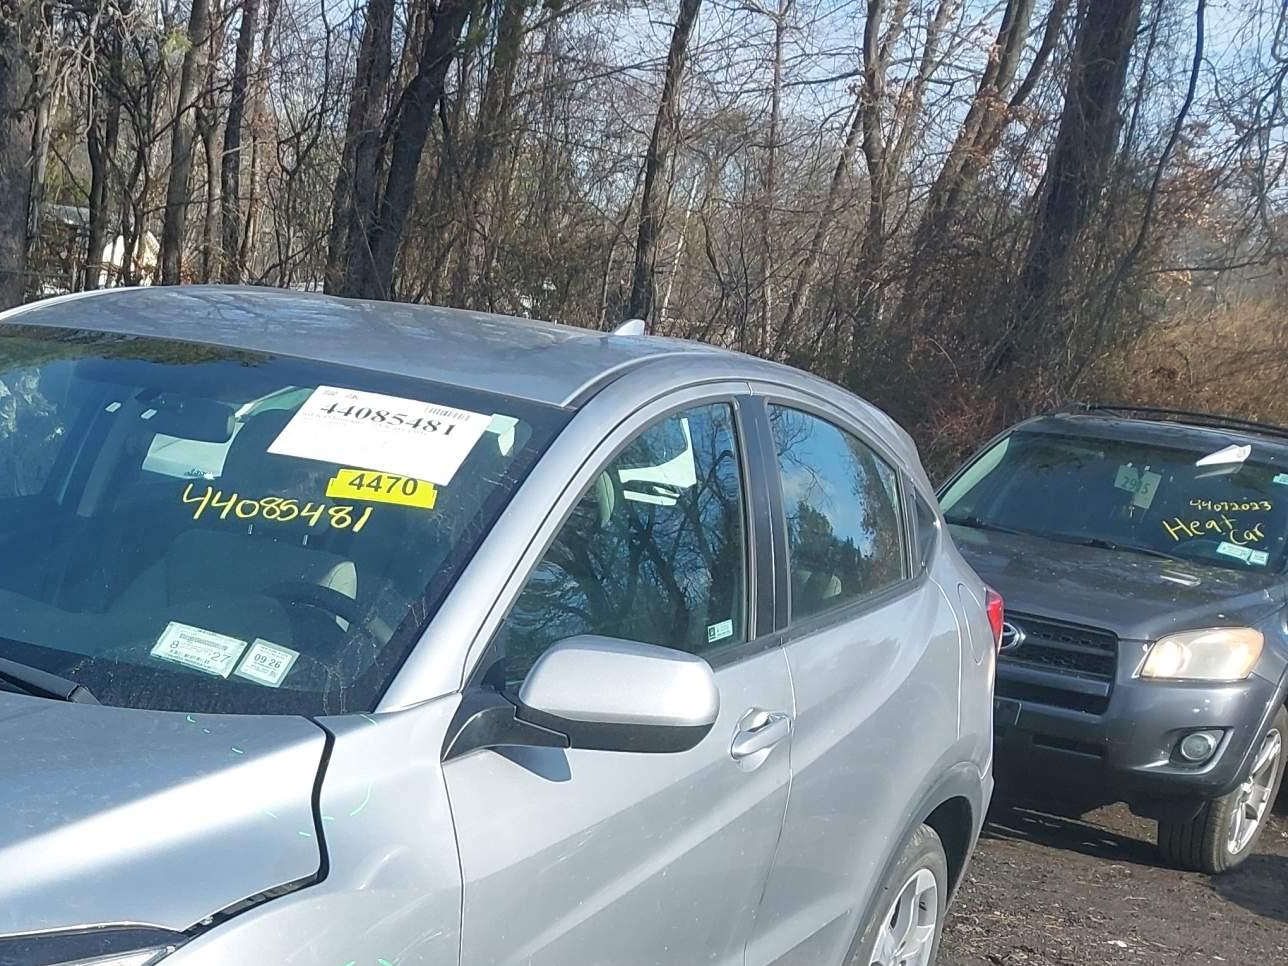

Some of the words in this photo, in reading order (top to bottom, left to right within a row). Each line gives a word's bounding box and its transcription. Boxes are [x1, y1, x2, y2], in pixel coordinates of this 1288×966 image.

[321, 402, 456, 436] 44085481
[348, 472, 418, 497] 4470
[182, 483, 374, 533] 44085481
[210, 651, 231, 664] 27
